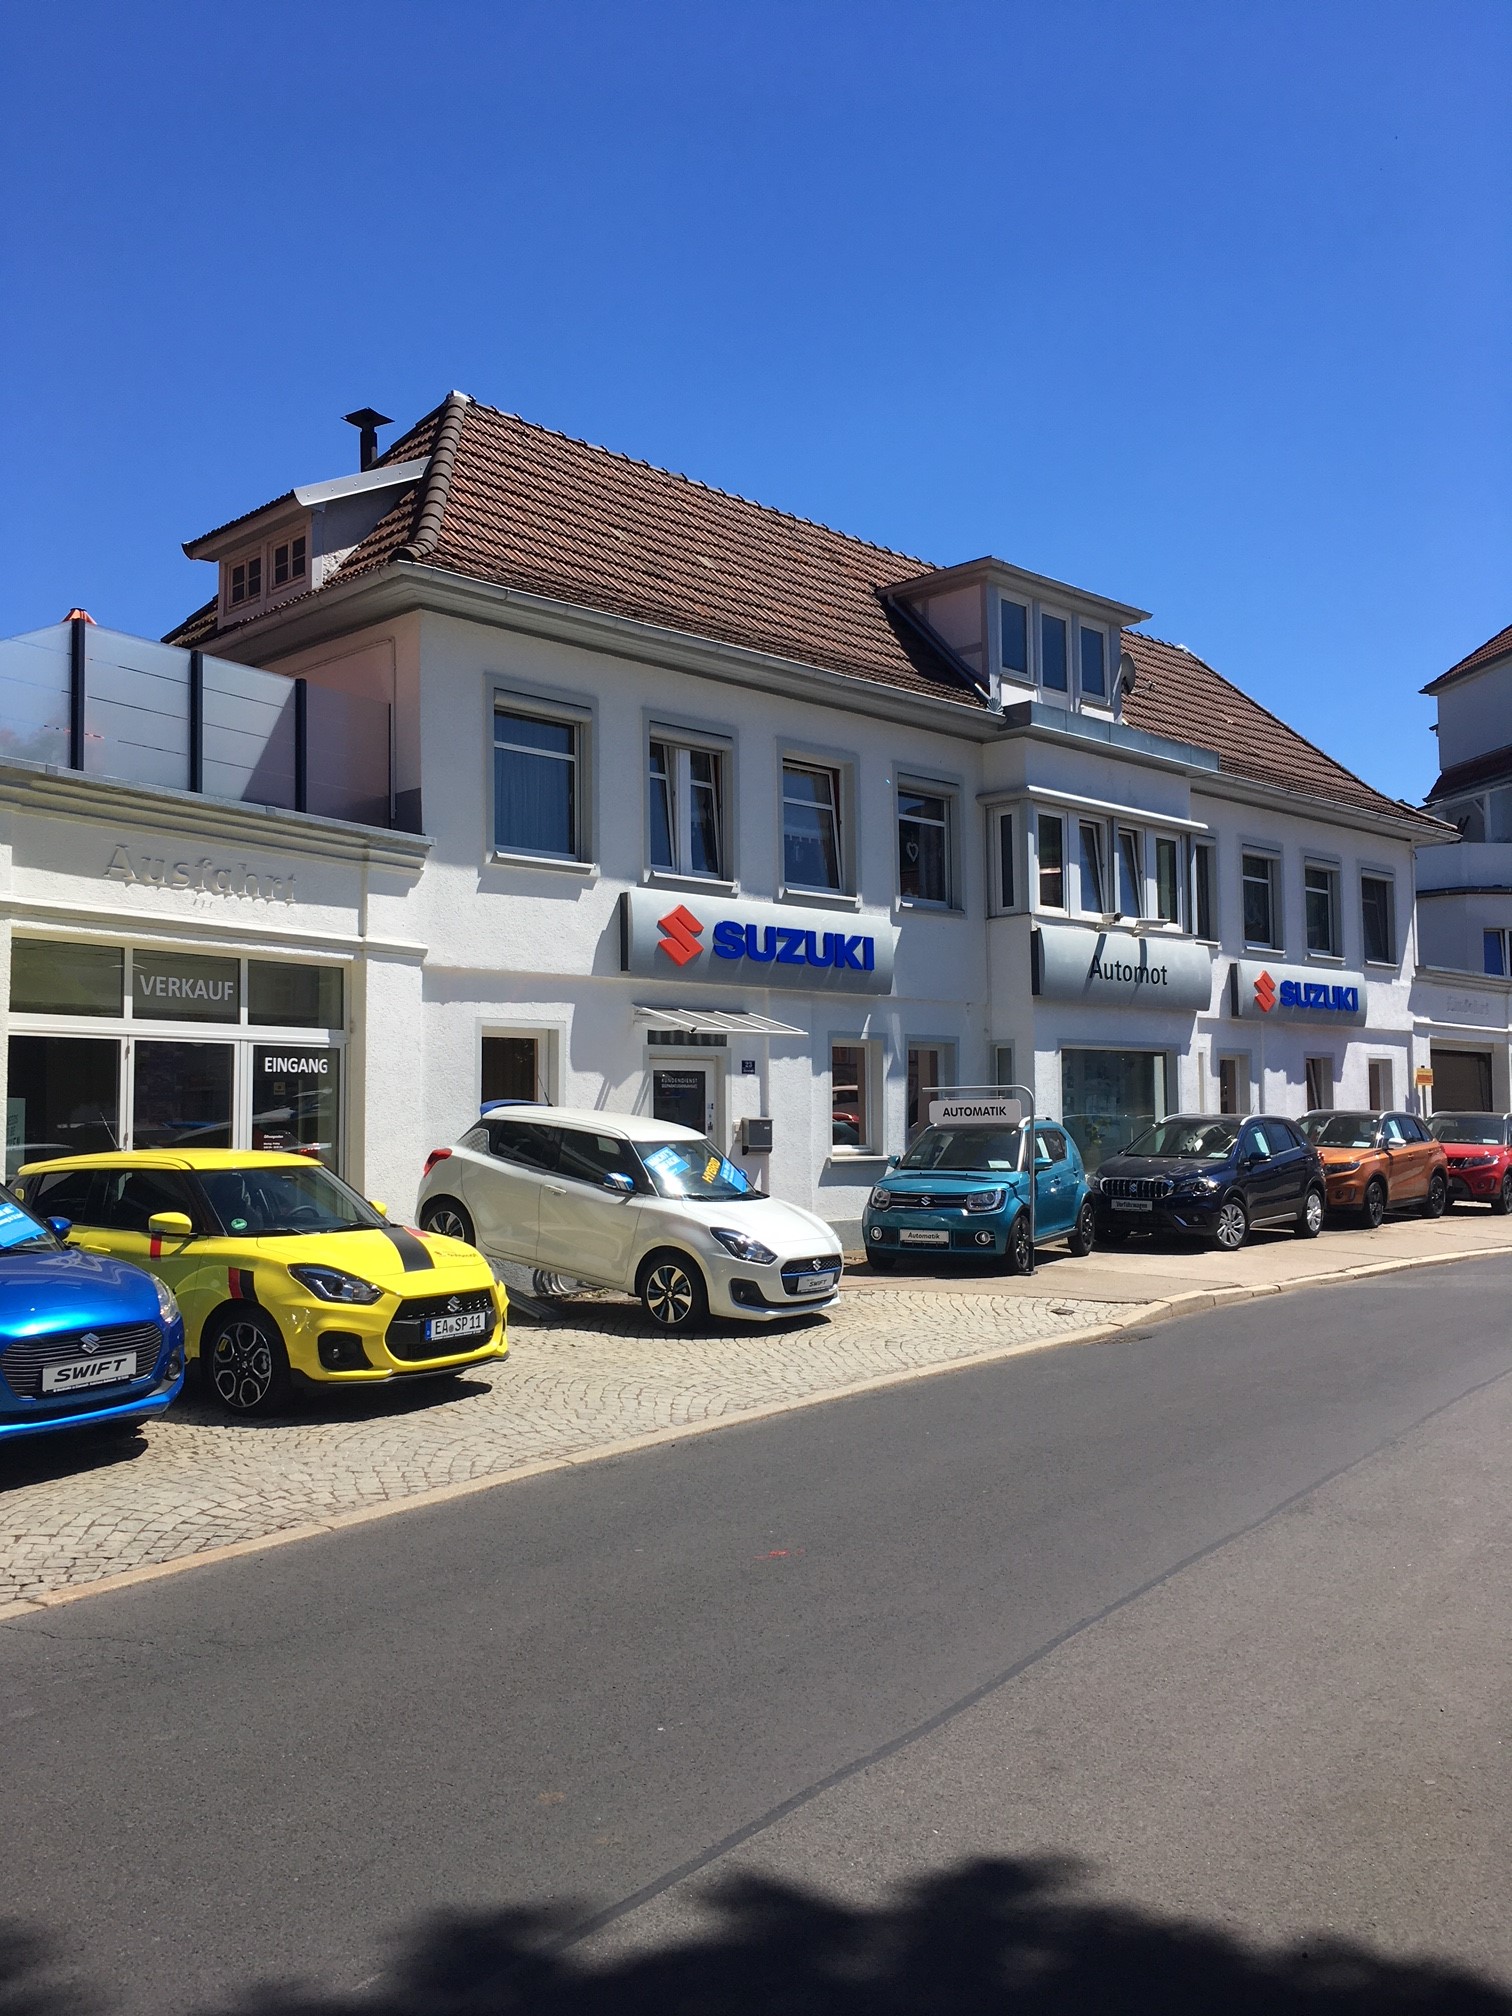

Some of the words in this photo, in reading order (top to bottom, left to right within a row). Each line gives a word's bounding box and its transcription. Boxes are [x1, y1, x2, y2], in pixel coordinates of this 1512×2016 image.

[104, 844, 297, 902] Ausfahrt
[713, 920, 875, 971] SUZUKI
[1089, 954, 1168, 985] Automot
[139, 974, 234, 1001] VERKAUF
[1279, 979, 1359, 1012] SUZUKI
[264, 1057, 328, 1074] EINGANG
[942, 1106, 1007, 1118] AUTOMATIK
[702, 1156, 720, 1184] HYBRID
[908, 1231, 940, 1239] Automatik
[435, 1320, 448, 1335] EA
[455, 1316, 468, 1331] SP
[470, 1314, 481, 1329] 11
[54, 1358, 127, 1382] SWIFT
